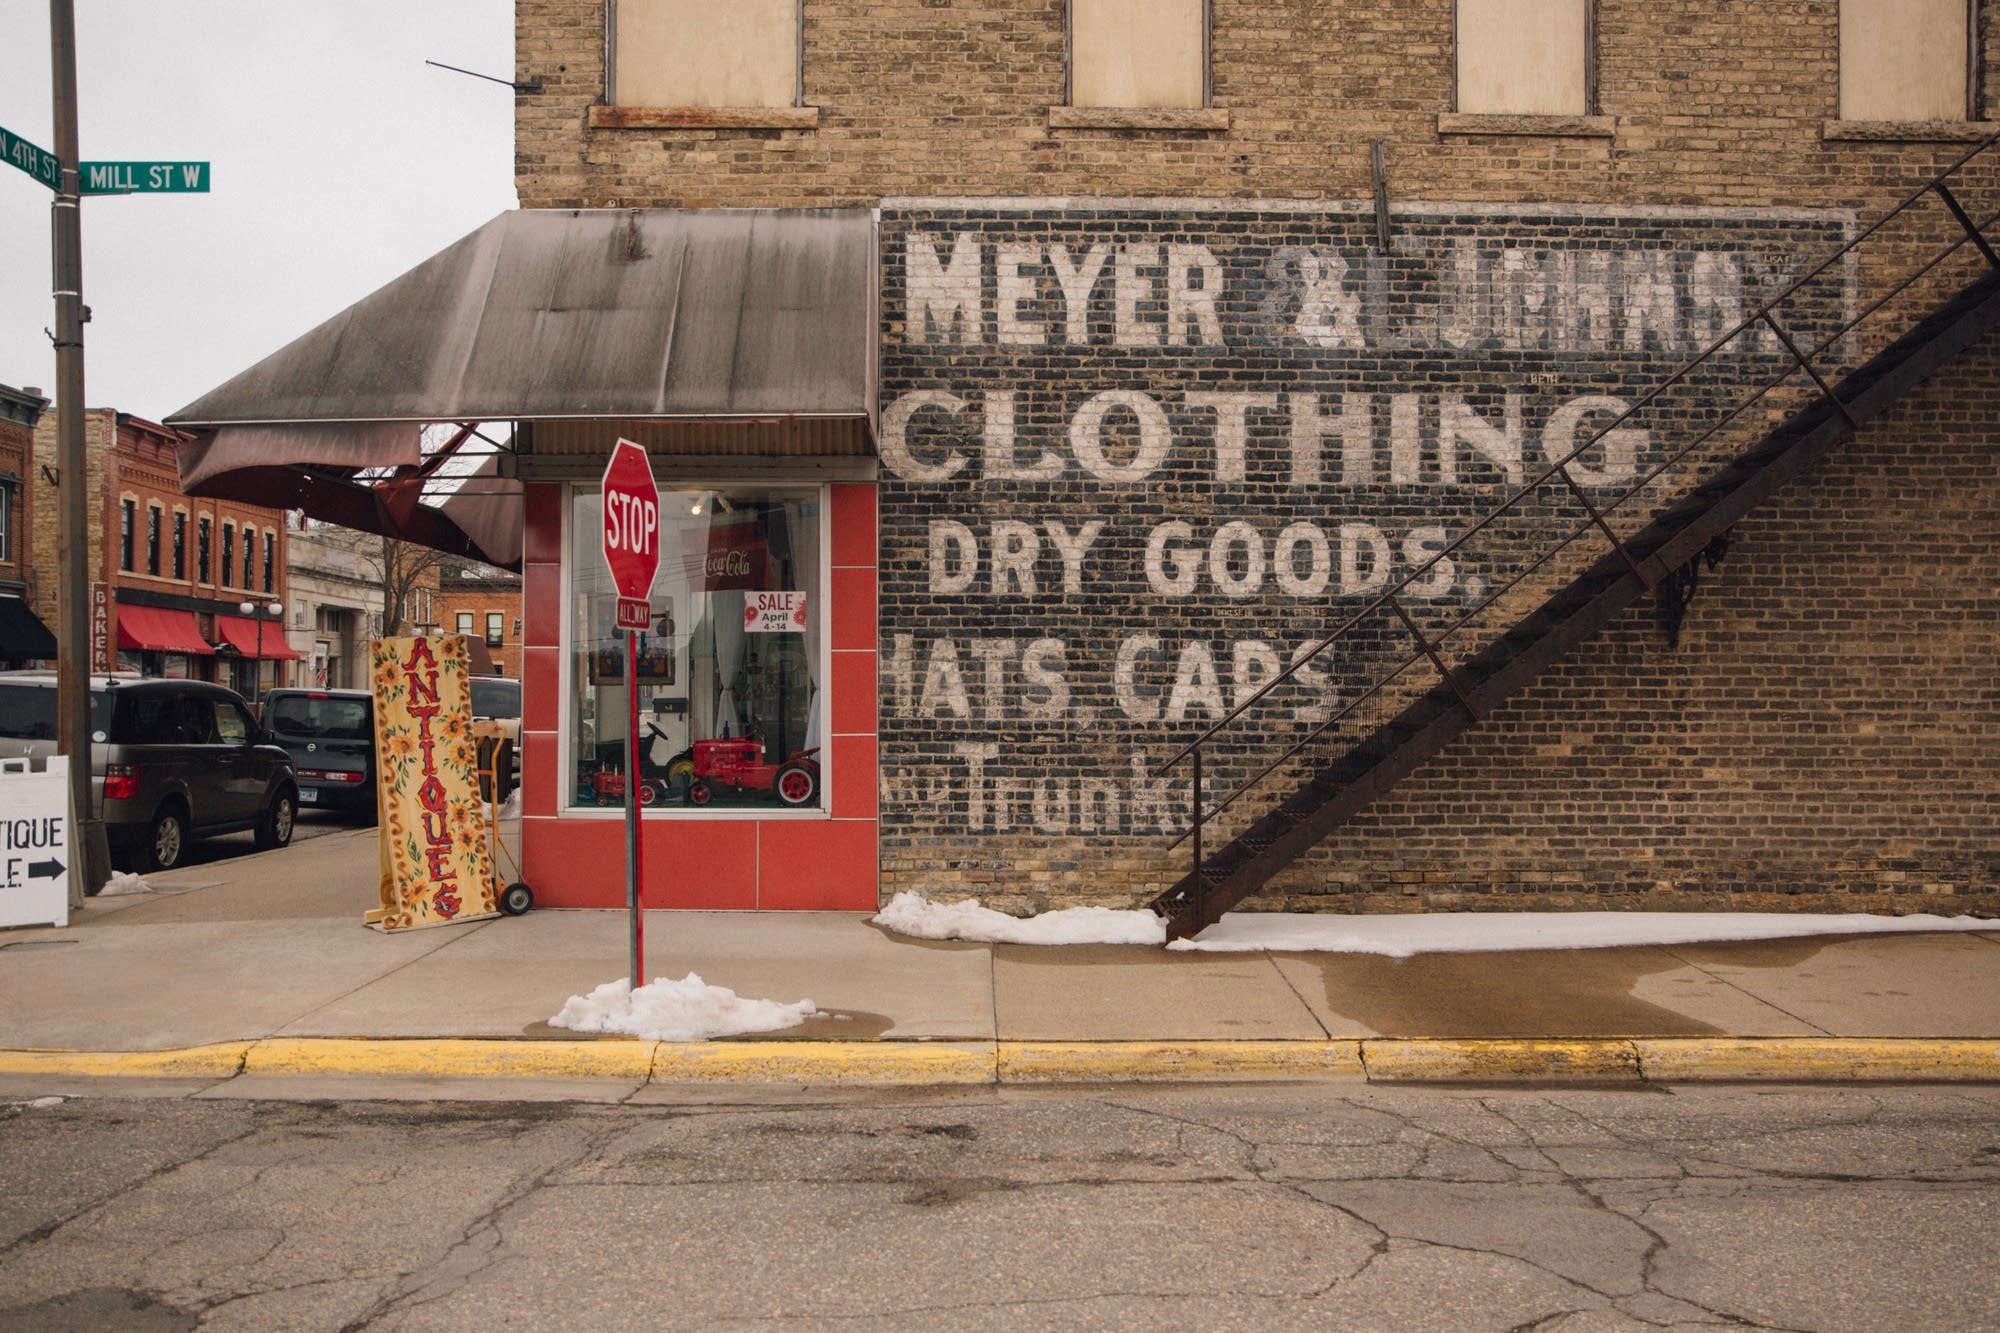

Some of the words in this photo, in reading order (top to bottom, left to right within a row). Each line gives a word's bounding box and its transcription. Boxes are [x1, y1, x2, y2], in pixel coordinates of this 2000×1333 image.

[12, 140, 37, 172] 4TH
[43, 155, 57, 182] ST
[90, 166, 139, 189] MILL
[149, 166, 173, 189] ST
[182, 166, 200, 188] W
[905, 231, 1226, 346] MEYER
[1294, 246, 1366, 348] &
[1531, 373, 1557, 384] BETH
[880, 389, 1657, 488] CLOTHING
[607, 489, 656, 555] STOP
[928, 519, 1104, 597] DRY
[619, 604, 632, 623] ALL
[634, 605, 649, 625] WAY
[758, 594, 793, 611] SALE
[762, 613, 788, 622] April
[1114, 634, 1336, 723] CAPS
[402, 637, 463, 919] ANTIQUES
